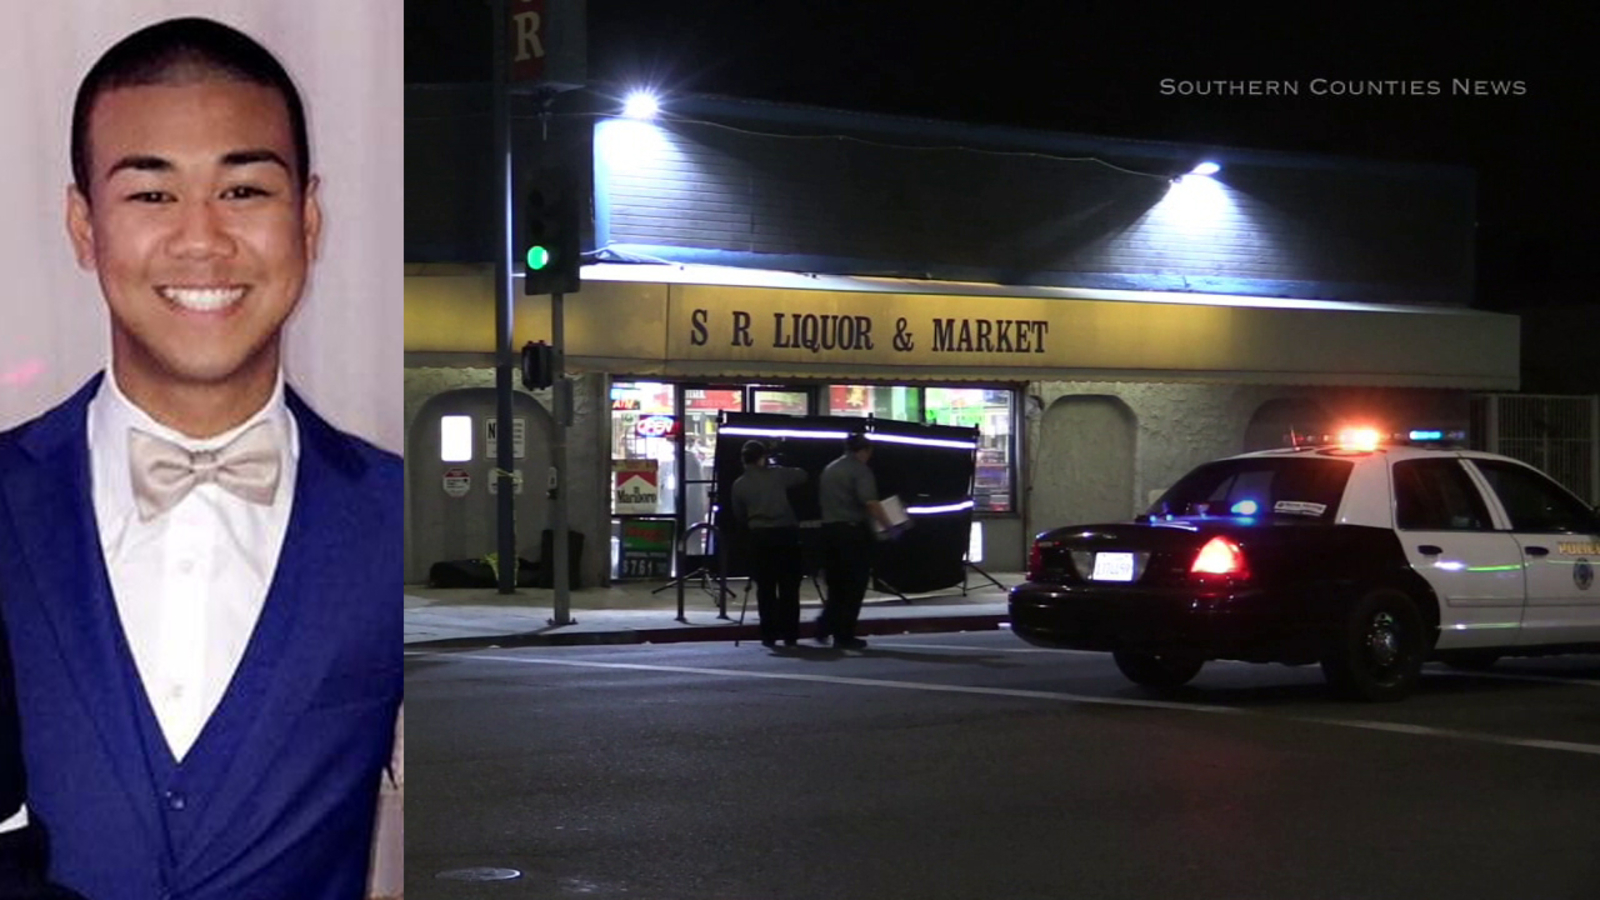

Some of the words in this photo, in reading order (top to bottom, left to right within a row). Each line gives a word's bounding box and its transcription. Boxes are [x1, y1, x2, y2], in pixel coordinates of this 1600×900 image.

[690, 309, 708, 347] S
[731, 310, 754, 348] R
[772, 313, 874, 353] LIQUOR
[892, 317, 914, 352] &
[932, 318, 1049, 353] MARKET
[637, 419, 674, 435] OPEN
